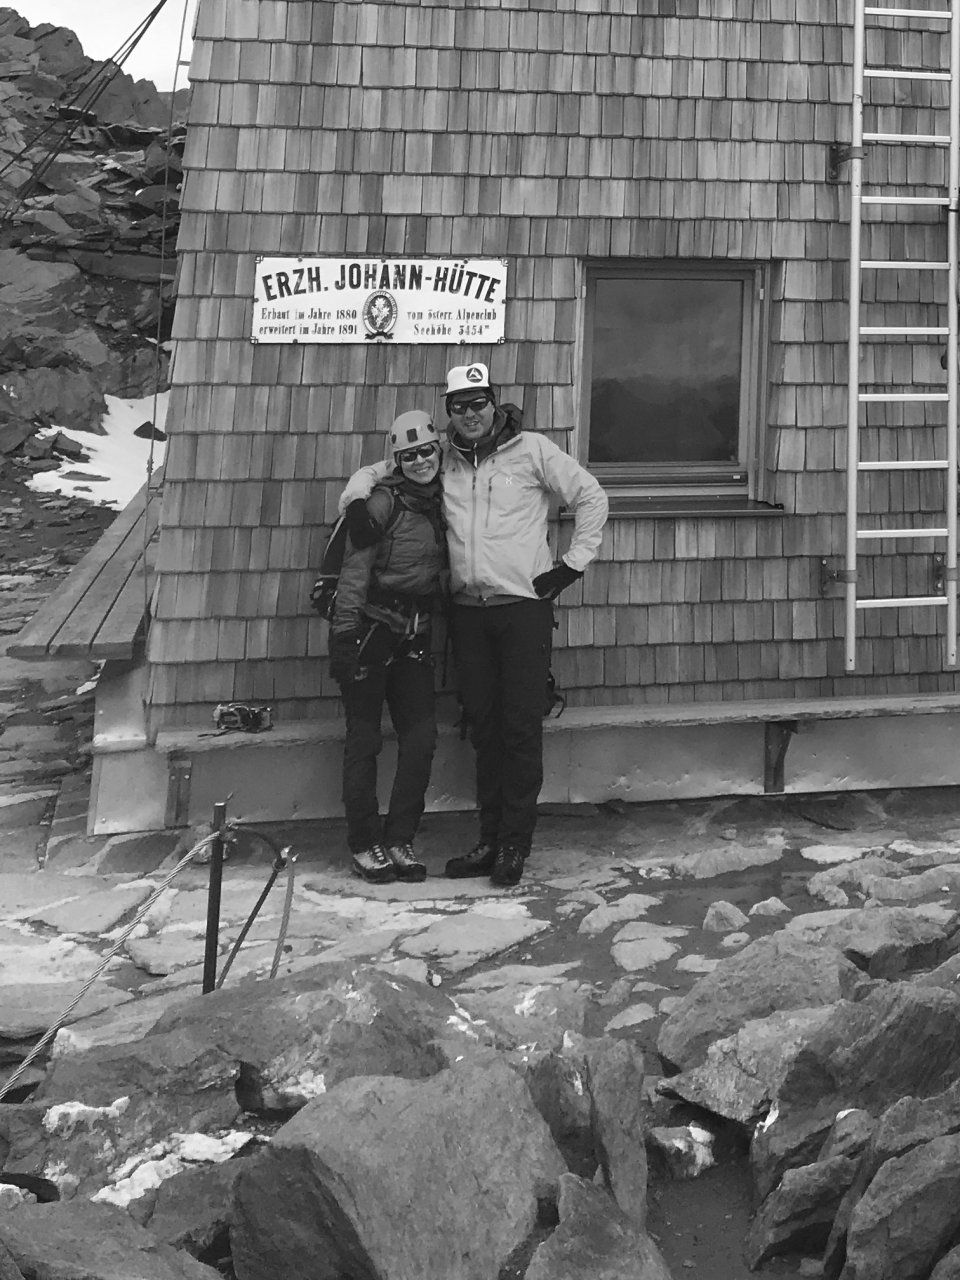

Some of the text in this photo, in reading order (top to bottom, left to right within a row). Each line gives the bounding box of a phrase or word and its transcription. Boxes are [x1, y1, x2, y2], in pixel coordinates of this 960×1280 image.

[262, 262, 501, 303] ERZH. JOHANN-HÜTTE
[261, 308, 357, 320] Erbaut im Jahre 1880
[407, 311, 423, 320] vom
[456, 308, 497, 323] Alpenclub
[259, 323, 357, 335] erweitert im Jahre 1891
[413, 323, 452, 336] Seehöhe
